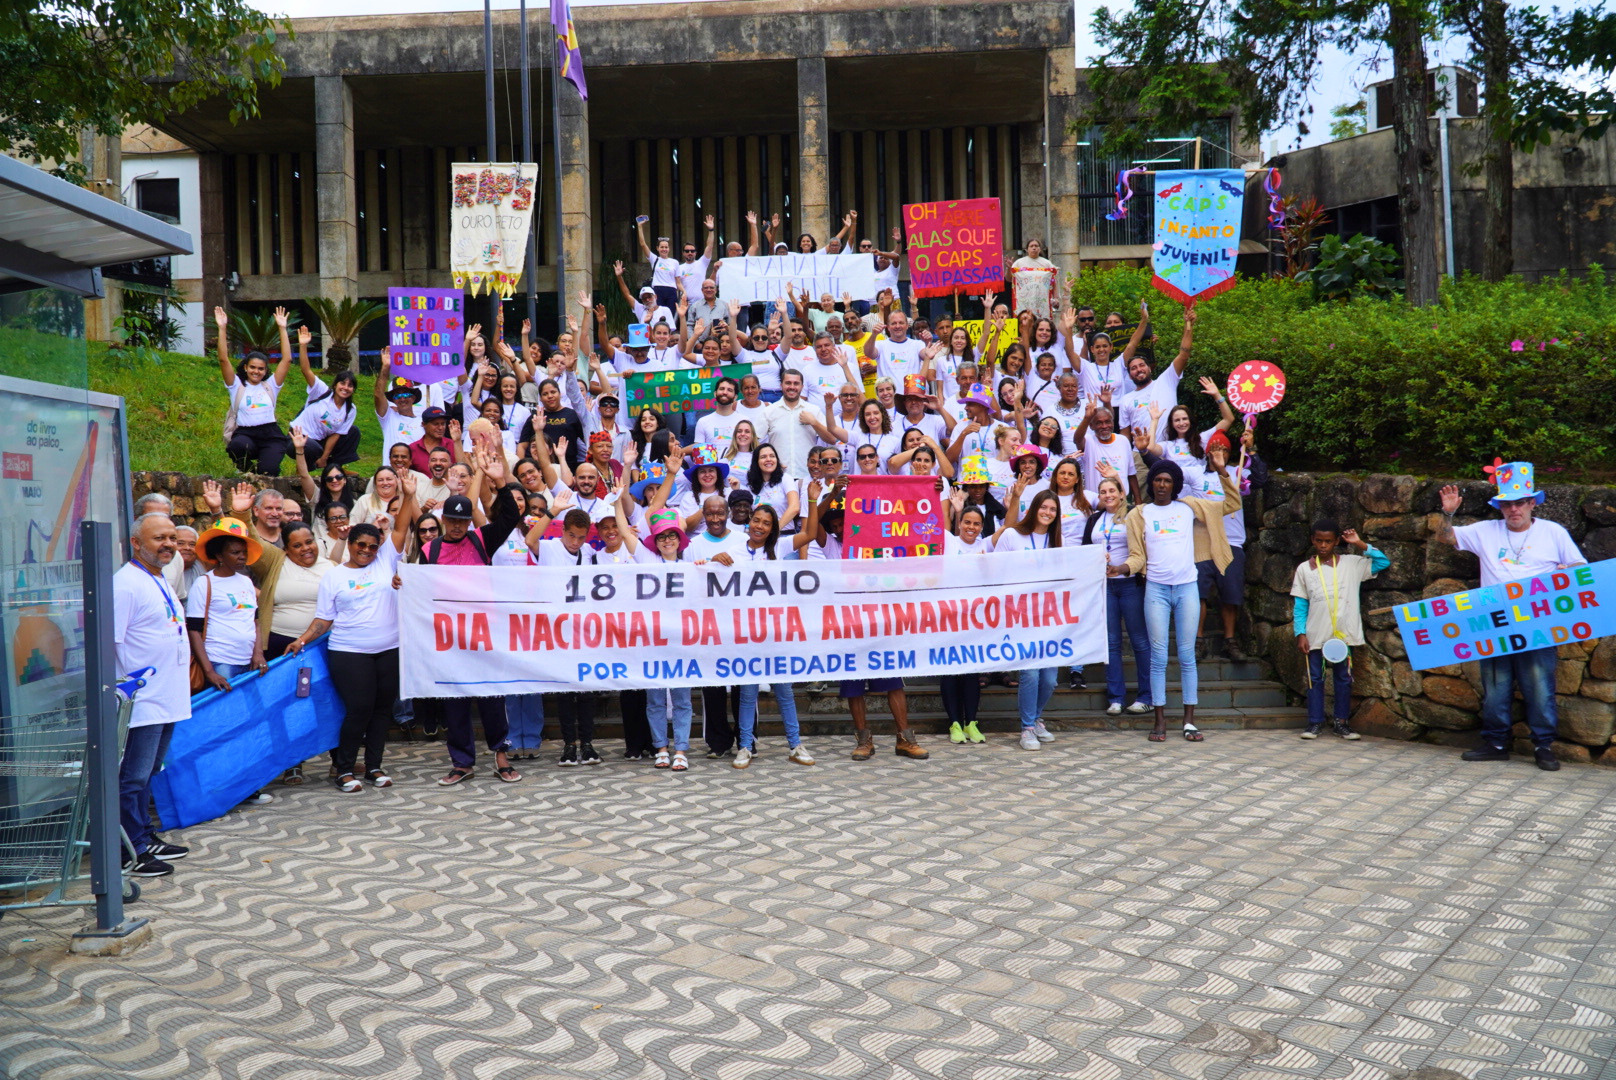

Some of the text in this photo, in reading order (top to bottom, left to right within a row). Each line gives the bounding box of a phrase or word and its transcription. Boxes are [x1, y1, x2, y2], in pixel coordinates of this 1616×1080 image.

[1168, 194, 1228, 212] CAPS
[462, 214, 492, 229] OURO
[910, 204, 984, 227] OH ABRE
[908, 228, 996, 250] ALAS QUE
[1160, 218, 1235, 239] INFANTO
[915, 249, 983, 271] O CAPS
[1160, 244, 1230, 265] JUVENIL
[912, 265, 1003, 289] VAI PASSAR
[391, 296, 460, 312] LIBERDADE
[392, 332, 450, 347] MELHOR
[394, 352, 460, 367] CUIDADO
[643, 367, 723, 383] POR UMA
[626, 382, 712, 401] SOCIEDADE
[1227, 379, 1284, 412] ACOLHIMENTO
[27, 420, 56, 434] do livro
[26, 436, 36, 446] ao
[850, 496, 932, 515] CUIDADO
[881, 522, 909, 538] EM
[848, 544, 938, 560] LIBERDADE
[565, 570, 820, 603] 18 DE MAIO
[1402, 566, 1595, 623] LIBERDADE
[433, 591, 1079, 651] DIA NACIONAL DA LUTA ANTIMANICOMIAL
[1442, 623, 1460, 638] O
[1467, 590, 1600, 633] MELHOR
[1454, 622, 1592, 660] CUIDADO
[578, 634, 1074, 681] POR UMA SOCIEDADE SEM MANICÔMIOS
